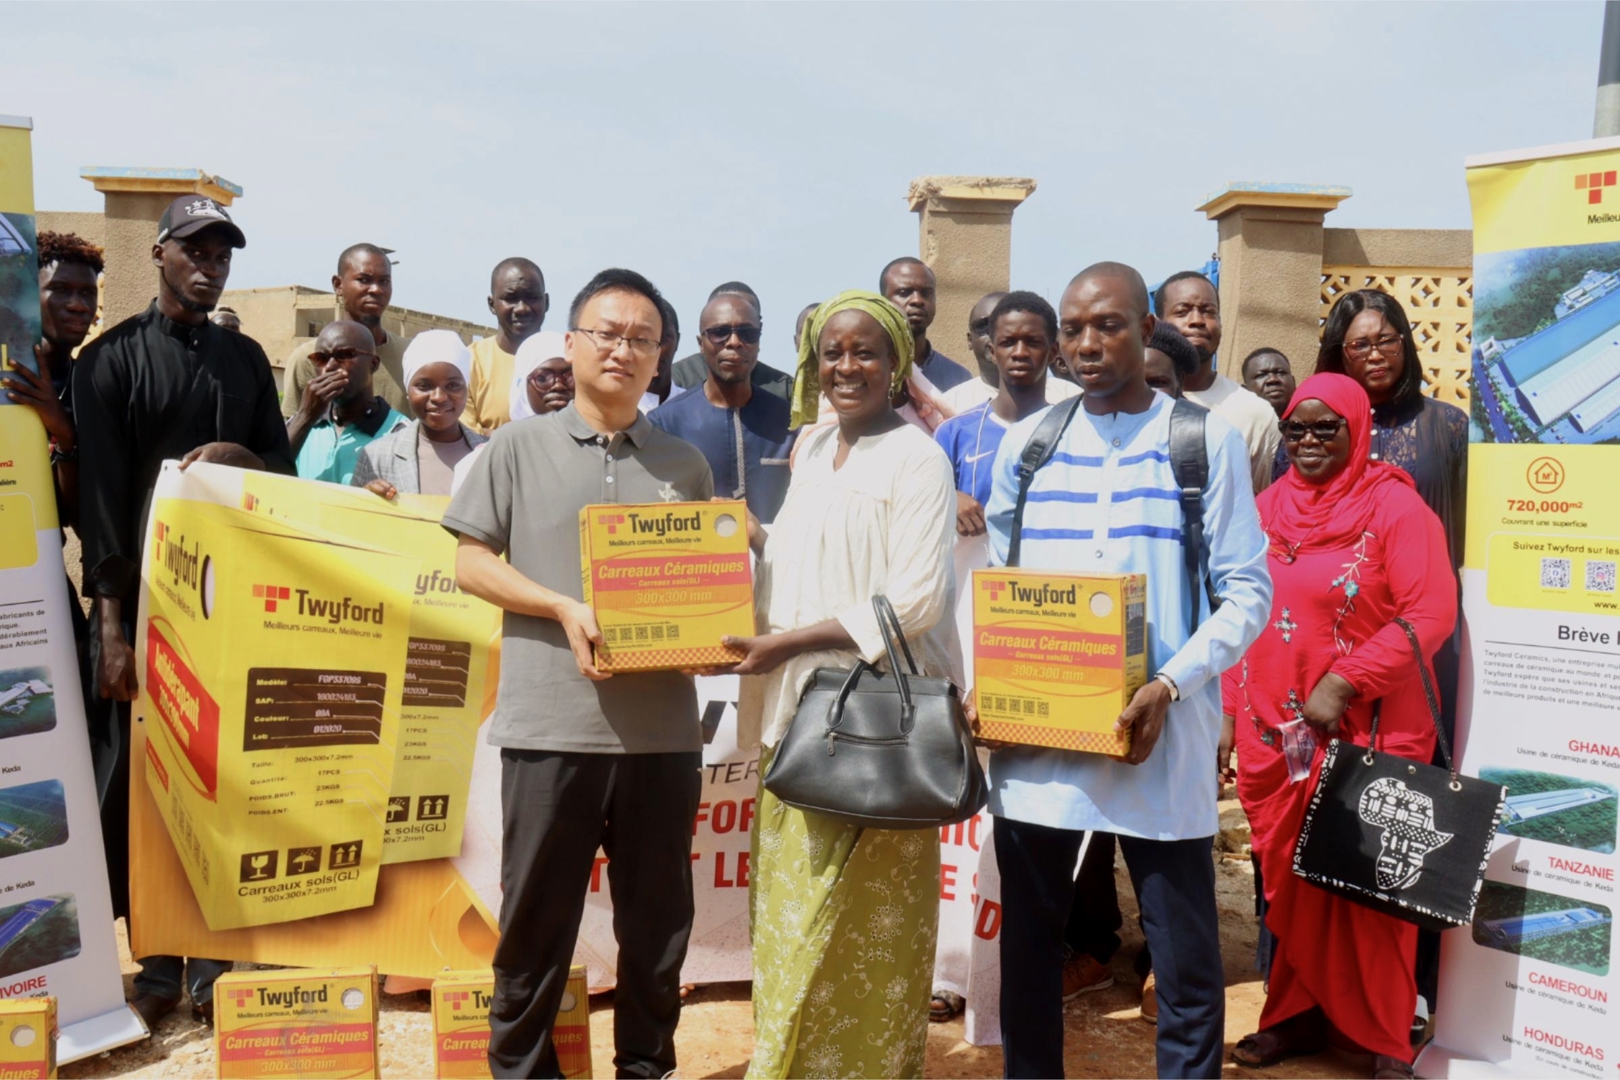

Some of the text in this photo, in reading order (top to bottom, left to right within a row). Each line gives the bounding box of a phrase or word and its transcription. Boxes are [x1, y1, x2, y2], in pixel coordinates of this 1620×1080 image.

[628, 511, 702, 536] Twyford
[1501, 518, 1535, 526] Couvrant
[1552, 519, 1588, 529] superficie
[164, 525, 199, 590] Twyford
[1513, 541, 1620, 556] Suivez Twyford sur les
[598, 560, 744, 579] Carreaux Céramiques
[637, 591, 713, 604] 300x300 mm
[1008, 581, 1076, 607] Twyford
[36, 609, 45, 617] de
[295, 589, 384, 625] Twyford
[263, 620, 383, 639] Meilleurs carreaux, Meilleure vie
[1558, 624, 1610, 645] Brève
[15, 638, 48, 648] Africains
[980, 631, 1117, 656] Carreaux Céramiques
[1484, 660, 1513, 668] carreaux
[1526, 663, 1563, 674] céramique
[1485, 649, 1513, 659] Twyford
[1568, 658, 1605, 669] entreprise
[1012, 664, 1084, 681] 300x300 mm
[1484, 669, 1512, 679] Twyford
[1541, 676, 1556, 684] que
[1573, 679, 1598, 688] usines
[1482, 688, 1491, 696] de
[1492, 689, 1525, 699] meilleurs
[1526, 694, 1557, 704] produits
[1581, 701, 1615, 711] meilleure
[1538, 685, 1583, 696] construction
[253, 715, 289, 723] Couleur:
[1517, 747, 1620, 769] Usine de céramique de Keda
[1568, 740, 1620, 758] GHANA
[395, 821, 447, 836] sols(GL)
[1548, 856, 1614, 881] TANZANIE
[4, 884, 14, 893] de
[16, 880, 35, 890] Keda
[238, 869, 360, 898] Carreaux sols(GL)
[1511, 864, 1614, 893] Usine de céramique de Keda
[262, 885, 338, 903] 300x300x7.2mm
[257, 984, 328, 1008] Twyford
[1528, 971, 1608, 1003] CAMEROUN
[1505, 980, 1607, 1015] Usine de céramique de Keda
[226, 1030, 369, 1050] Carreaux Céramiques
[443, 1038, 490, 1051] Carrea
[1523, 1026, 1605, 1061] HONDURAS
[1502, 1034, 1604, 1071] Usine de céramique de Keda
[314, 1060, 336, 1069] mm
